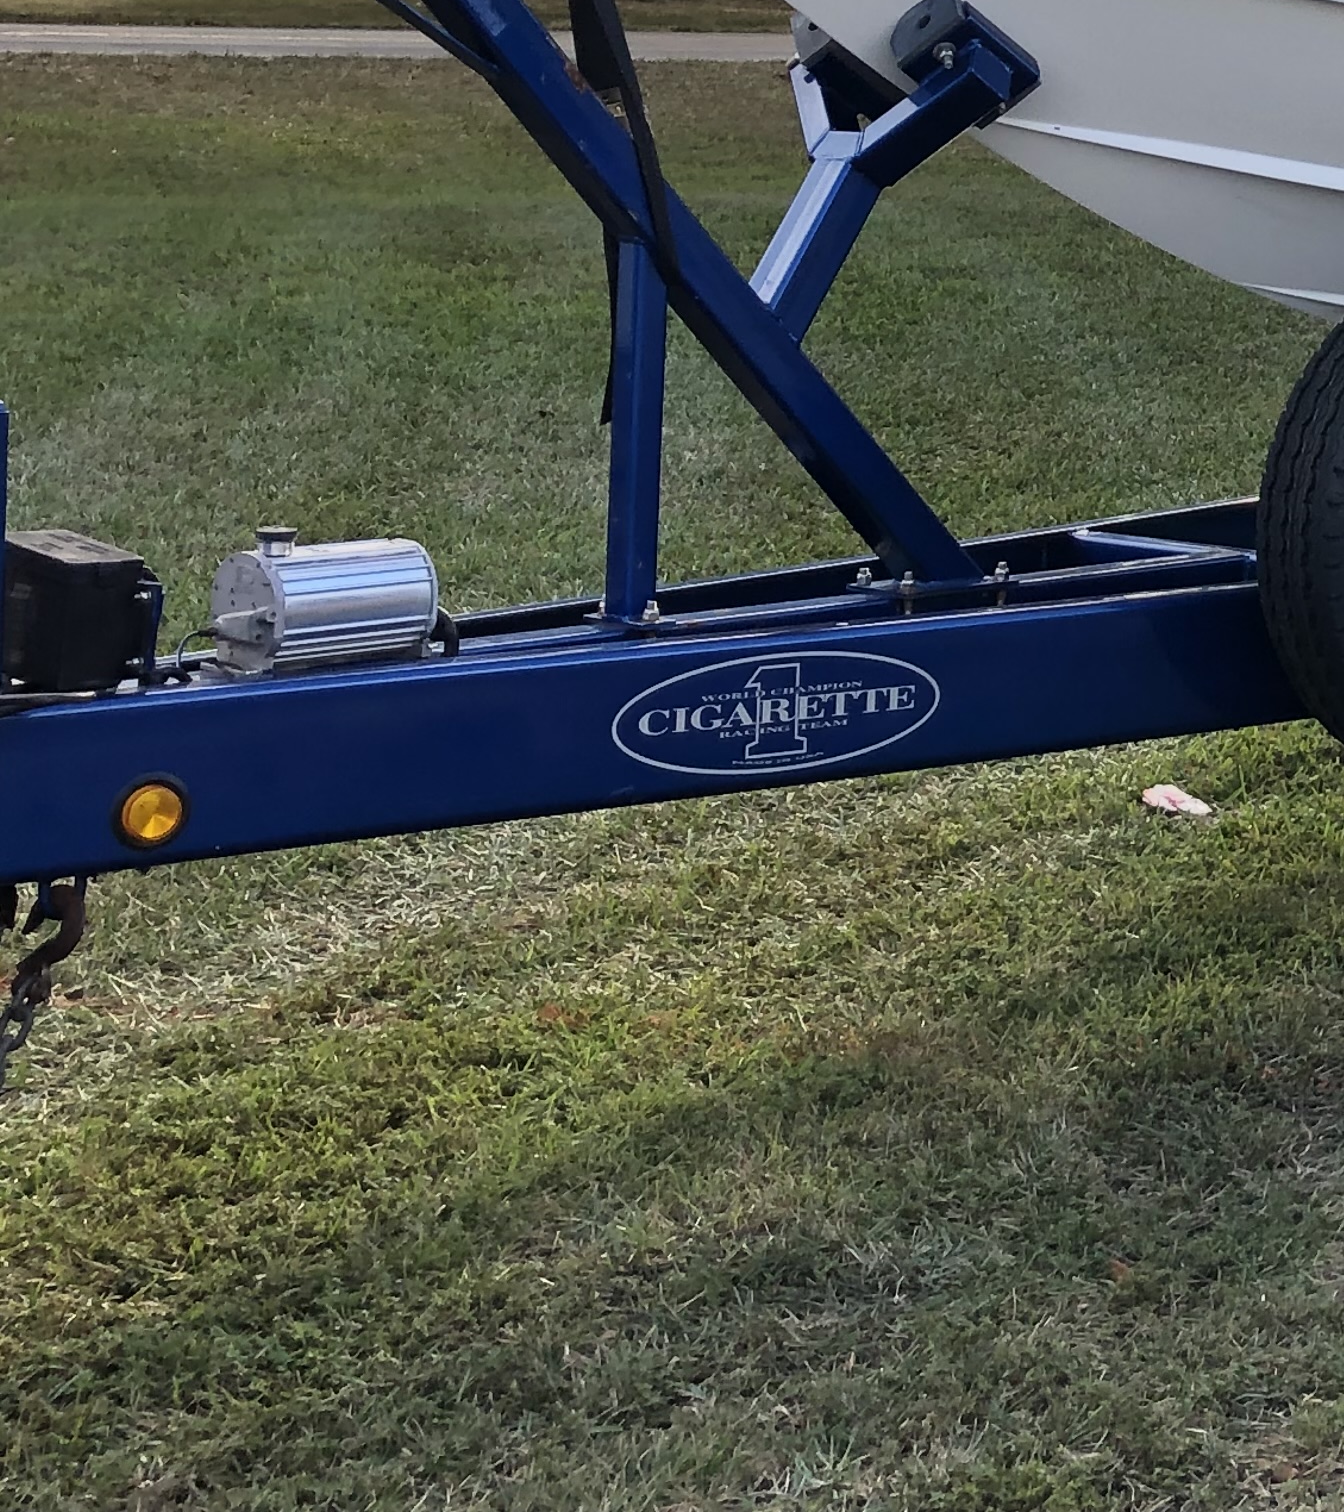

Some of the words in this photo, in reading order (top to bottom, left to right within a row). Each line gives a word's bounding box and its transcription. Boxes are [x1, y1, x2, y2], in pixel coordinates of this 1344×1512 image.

[701, 689, 766, 702] WORLD
[770, 680, 863, 696] CHAMPION
[637, 684, 916, 737] CIGARETTE
[799, 719, 849, 730] TEAM
